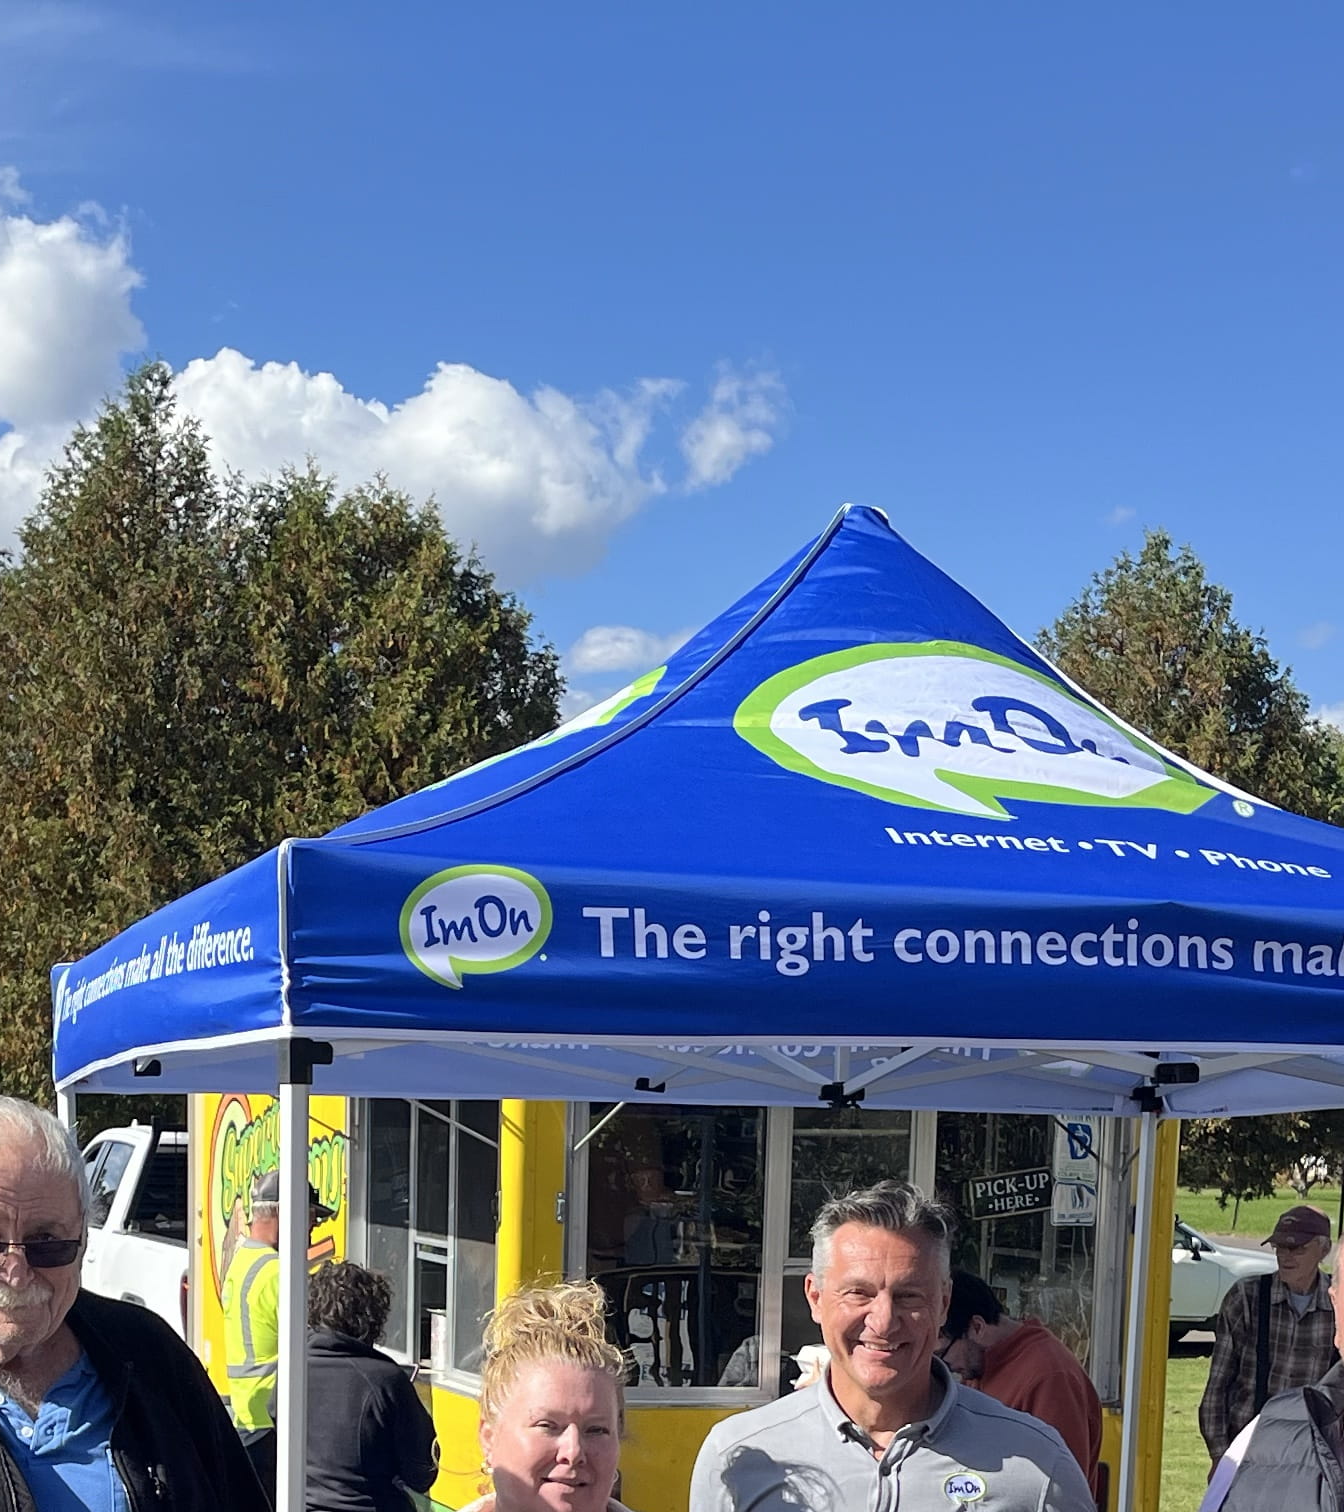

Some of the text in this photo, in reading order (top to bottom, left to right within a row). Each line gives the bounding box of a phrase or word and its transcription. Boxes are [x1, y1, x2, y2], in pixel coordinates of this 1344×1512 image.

[884, 827, 1332, 880] Internet TV Phone
[419, 894, 534, 949] ImOn
[582, 906, 707, 960] The
[729, 910, 875, 977] right
[893, 918, 1234, 969] connections
[150, 935, 168, 981] all
[165, 931, 185, 976] the
[186, 921, 255, 972] difference.
[974, 1172, 1050, 1199] PICK-UP
[947, 1481, 981, 1494] ImOn
